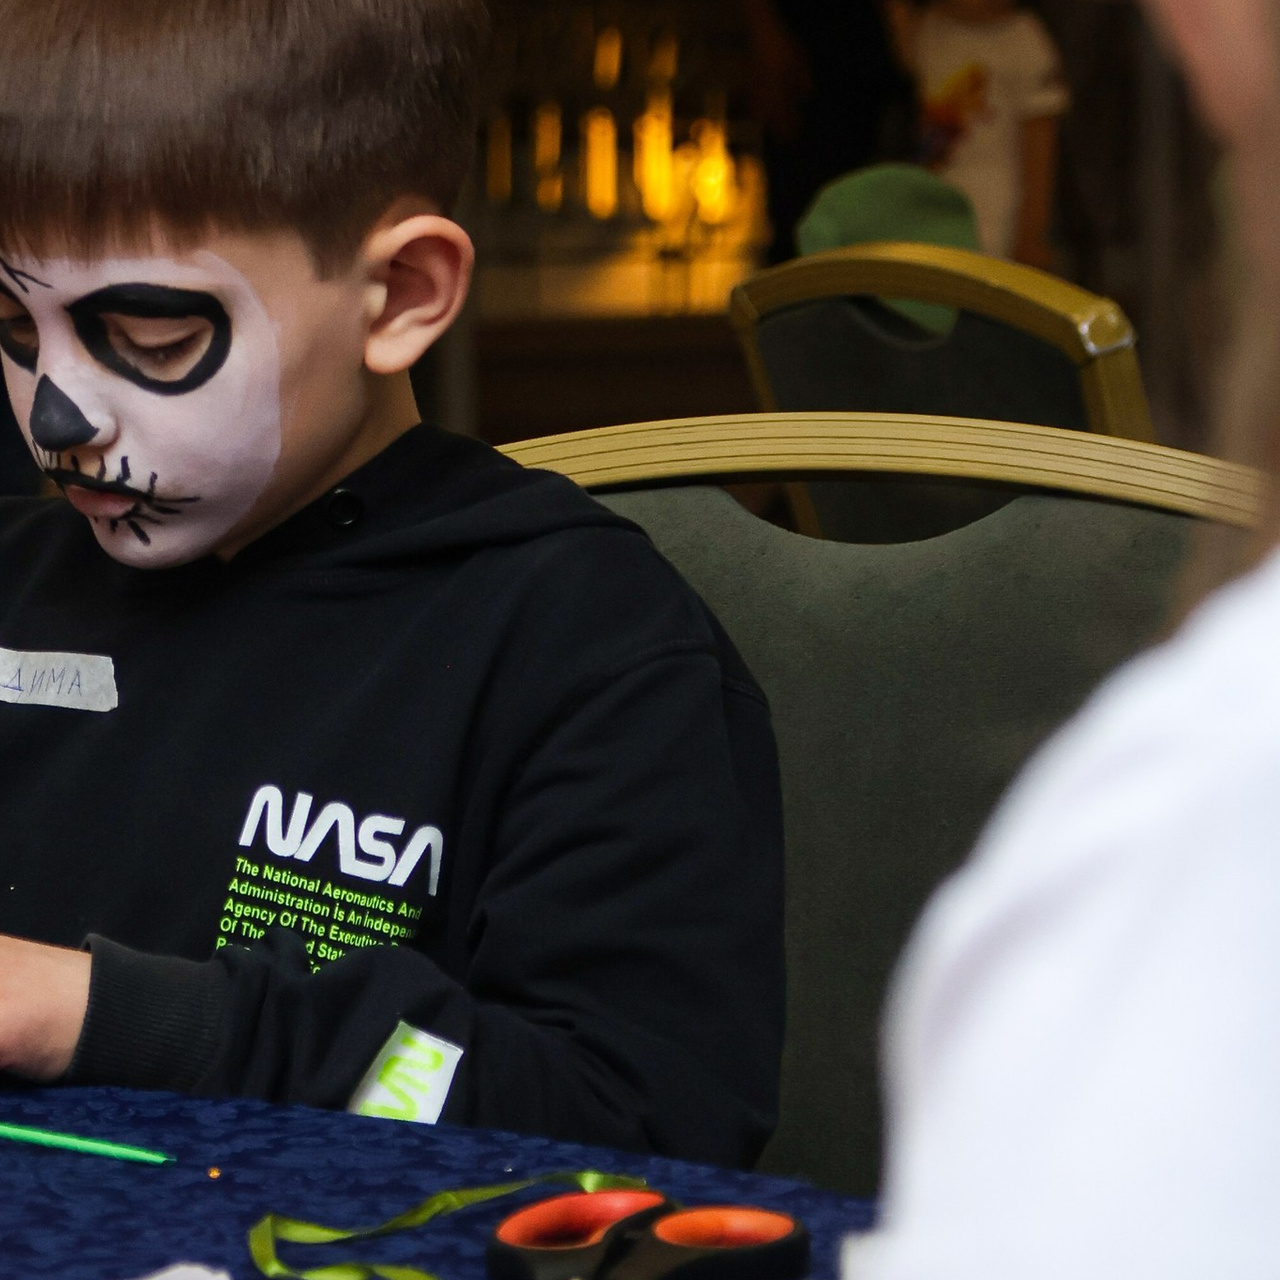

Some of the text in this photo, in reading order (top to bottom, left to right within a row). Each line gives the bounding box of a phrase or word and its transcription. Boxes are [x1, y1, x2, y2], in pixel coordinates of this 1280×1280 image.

[238, 784, 444, 896] NASA
[229, 878, 330, 917] Administration
[347, 911, 362, 925] An
[236, 857, 259, 876] The
[263, 865, 320, 893] National
[322, 883, 394, 914] Aeronautics
[220, 917, 238, 933] Of
[242, 922, 265, 939] The
[224, 898, 277, 926] Agency
[280, 912, 298, 928] Of
[301, 916, 325, 937] The
[329, 925, 384, 948] Executiv
